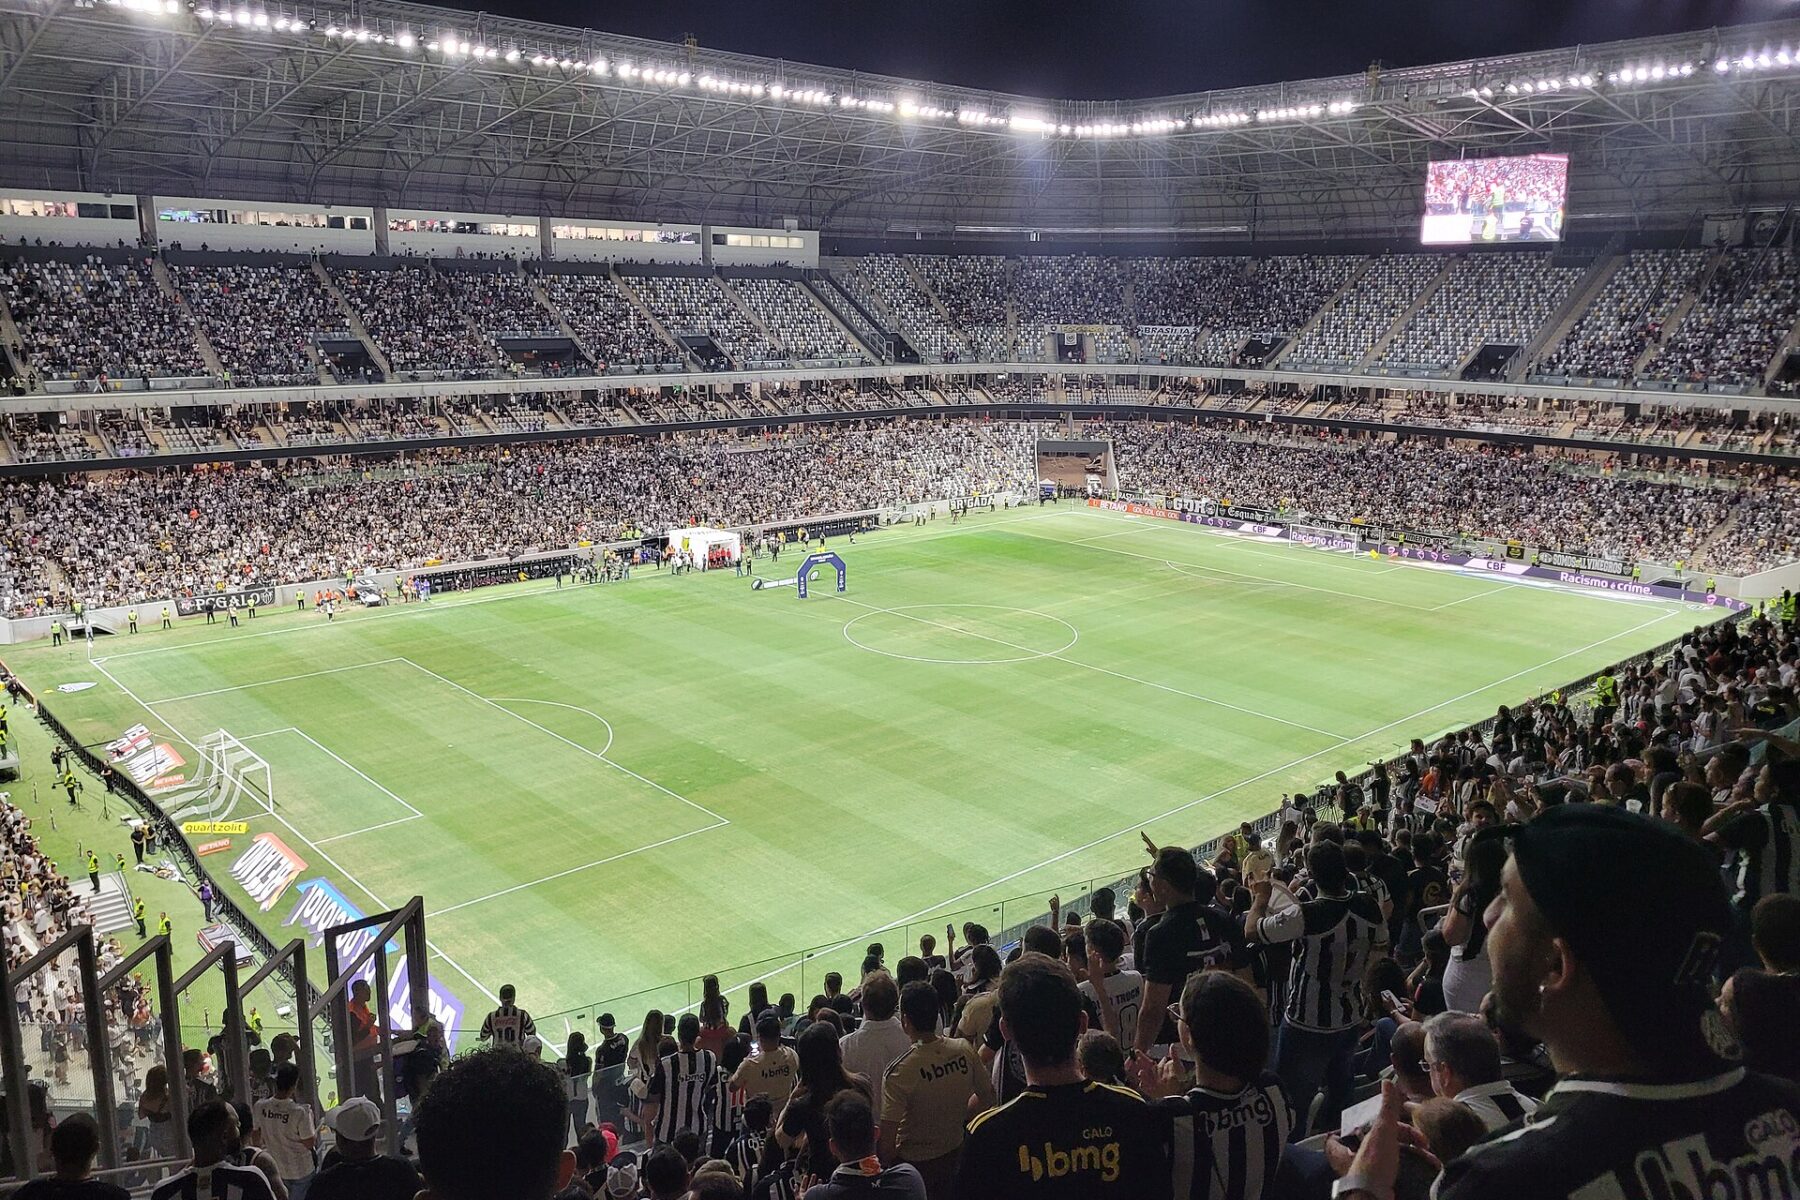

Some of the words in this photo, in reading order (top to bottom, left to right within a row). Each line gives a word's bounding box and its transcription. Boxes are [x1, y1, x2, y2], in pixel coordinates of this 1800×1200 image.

[1252, 525, 1267, 534] CBF
[1292, 532, 1327, 545] Racismo
[1486, 561, 1506, 571] CBF
[1552, 554, 1576, 567] SOMOS
[1560, 572, 1609, 589] Racismo
[1617, 581, 1653, 595] crime.
[185, 823, 243, 833] quartzolit
[769, 1065, 790, 1078] bmg
[931, 1055, 969, 1079] bmg
[685, 1072, 706, 1081] bmg
[268, 1109, 290, 1124] bmg
[1217, 1093, 1270, 1130] bmg
[1083, 1126, 1113, 1140] GALO
[1045, 1142, 1120, 1182] bmg
